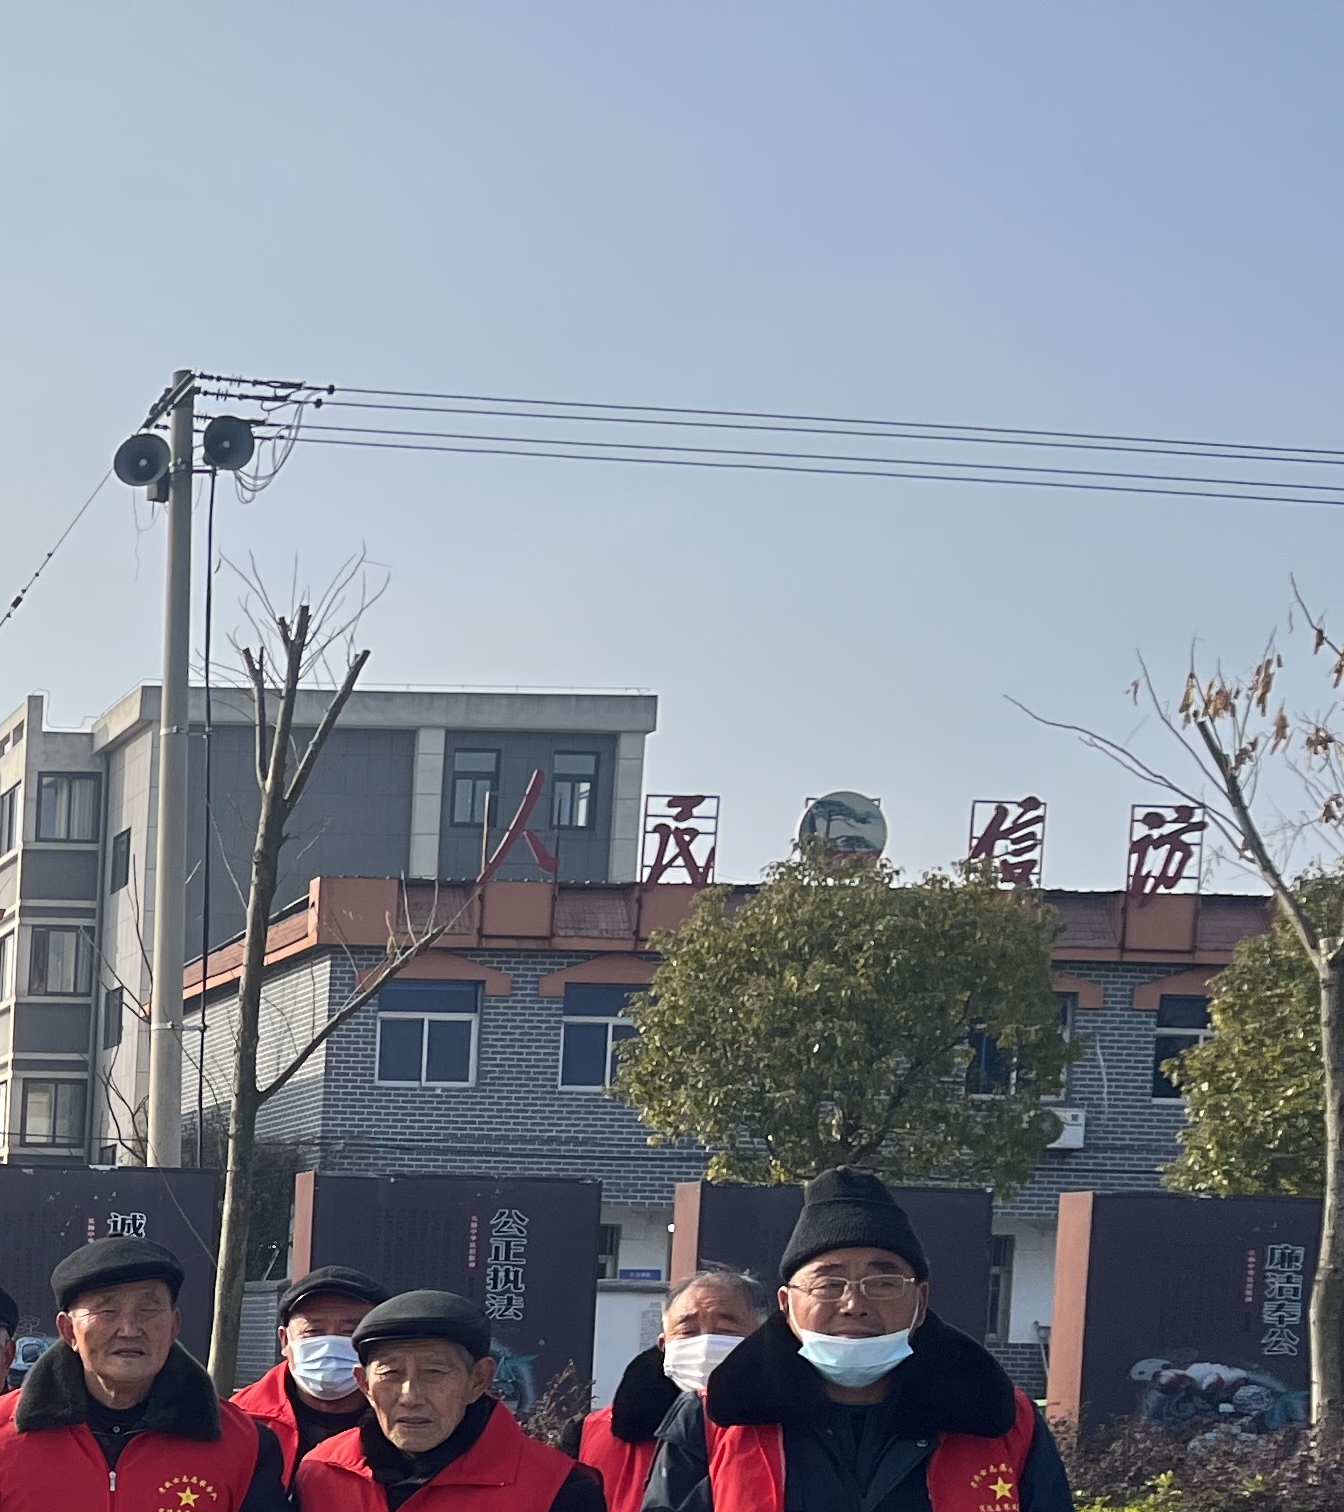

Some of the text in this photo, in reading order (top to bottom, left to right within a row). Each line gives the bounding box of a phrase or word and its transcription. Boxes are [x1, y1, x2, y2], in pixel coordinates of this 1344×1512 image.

[485, 1208, 529, 1321] 公正执法
[1261, 1243, 1305, 1356] 廉洁奉公
